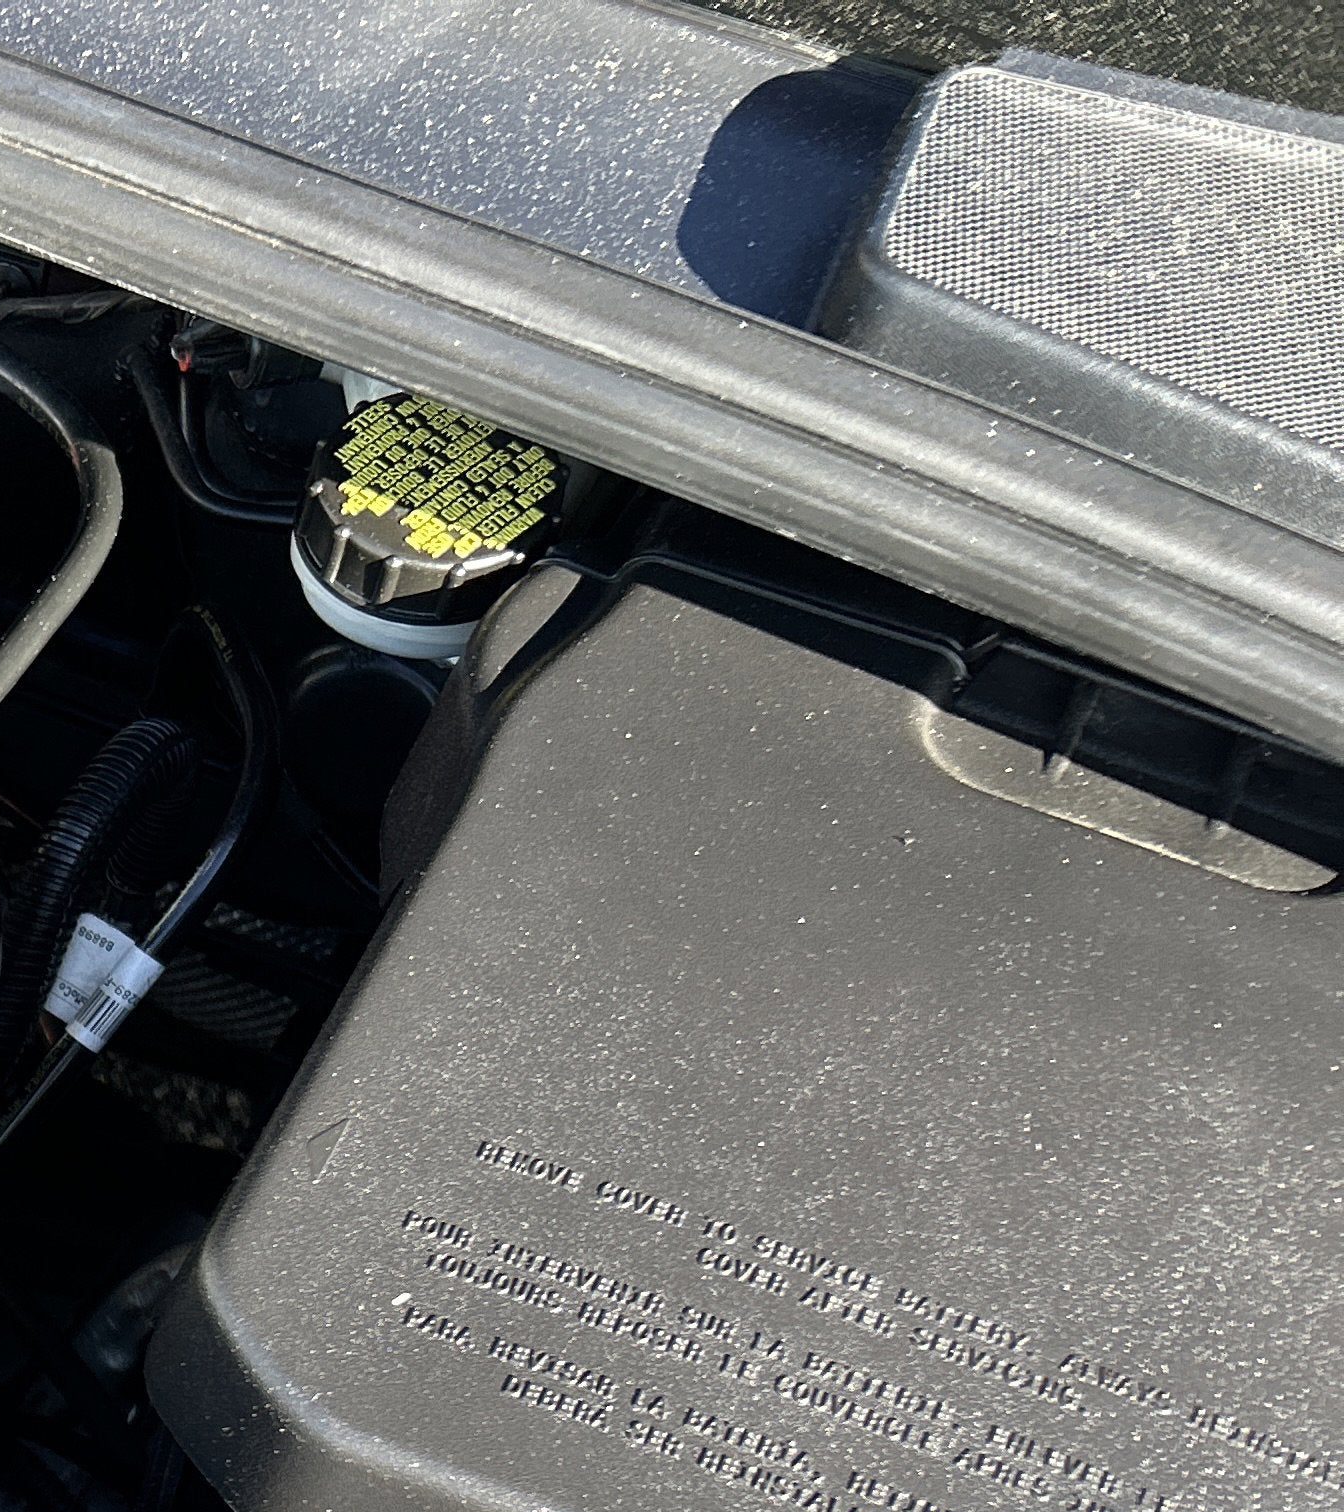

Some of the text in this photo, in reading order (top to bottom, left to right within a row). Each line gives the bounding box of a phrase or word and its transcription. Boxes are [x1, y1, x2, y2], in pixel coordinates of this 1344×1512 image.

[335, 414, 398, 462] CONTENANT
[344, 425, 407, 474] PROVENANT
[385, 445, 406, 463] DU
[402, 428, 431, 449] QUE
[425, 436, 445, 454] LE
[506, 441, 521, 453] A
[424, 456, 444, 474] LE
[466, 450, 510, 483] SEALED
[512, 446, 544, 472] ONLY
[488, 467, 515, 489] DOT
[509, 459, 554, 493] BEFORE
[441, 493, 479, 522] FLUID
[515, 478, 555, 509] CLEAN
[476, 505, 519, 537] FILLER
[474, 1136, 584, 1195] REMOVE
[594, 1178, 688, 1229] COVER
[698, 1214, 741, 1248] TO
[749, 1232, 883, 1300] SERVICE
[1055, 1350, 1176, 1415] ALWAYS
[693, 1245, 791, 1299] COVER
[796, 1283, 900, 1339] AFTER
[400, 1206, 478, 1253] POUR
[485, 1234, 667, 1318] INTERVENIR
[675, 1303, 738, 1343] SUR
[746, 1329, 790, 1362] LA
[982, 1424, 1123, 1497] ENLEVER
[401, 1304, 477, 1349] PARA
[486, 1335, 620, 1402] REVISAR
[628, 1387, 674, 1422] LA
[422, 1245, 568, 1317] TOUJOURS
[575, 1301, 705, 1365] REPOSER
[717, 1352, 760, 1385] LE
[770, 1372, 940, 1455] COUVERCLE
[622, 1418, 685, 1458] SER
